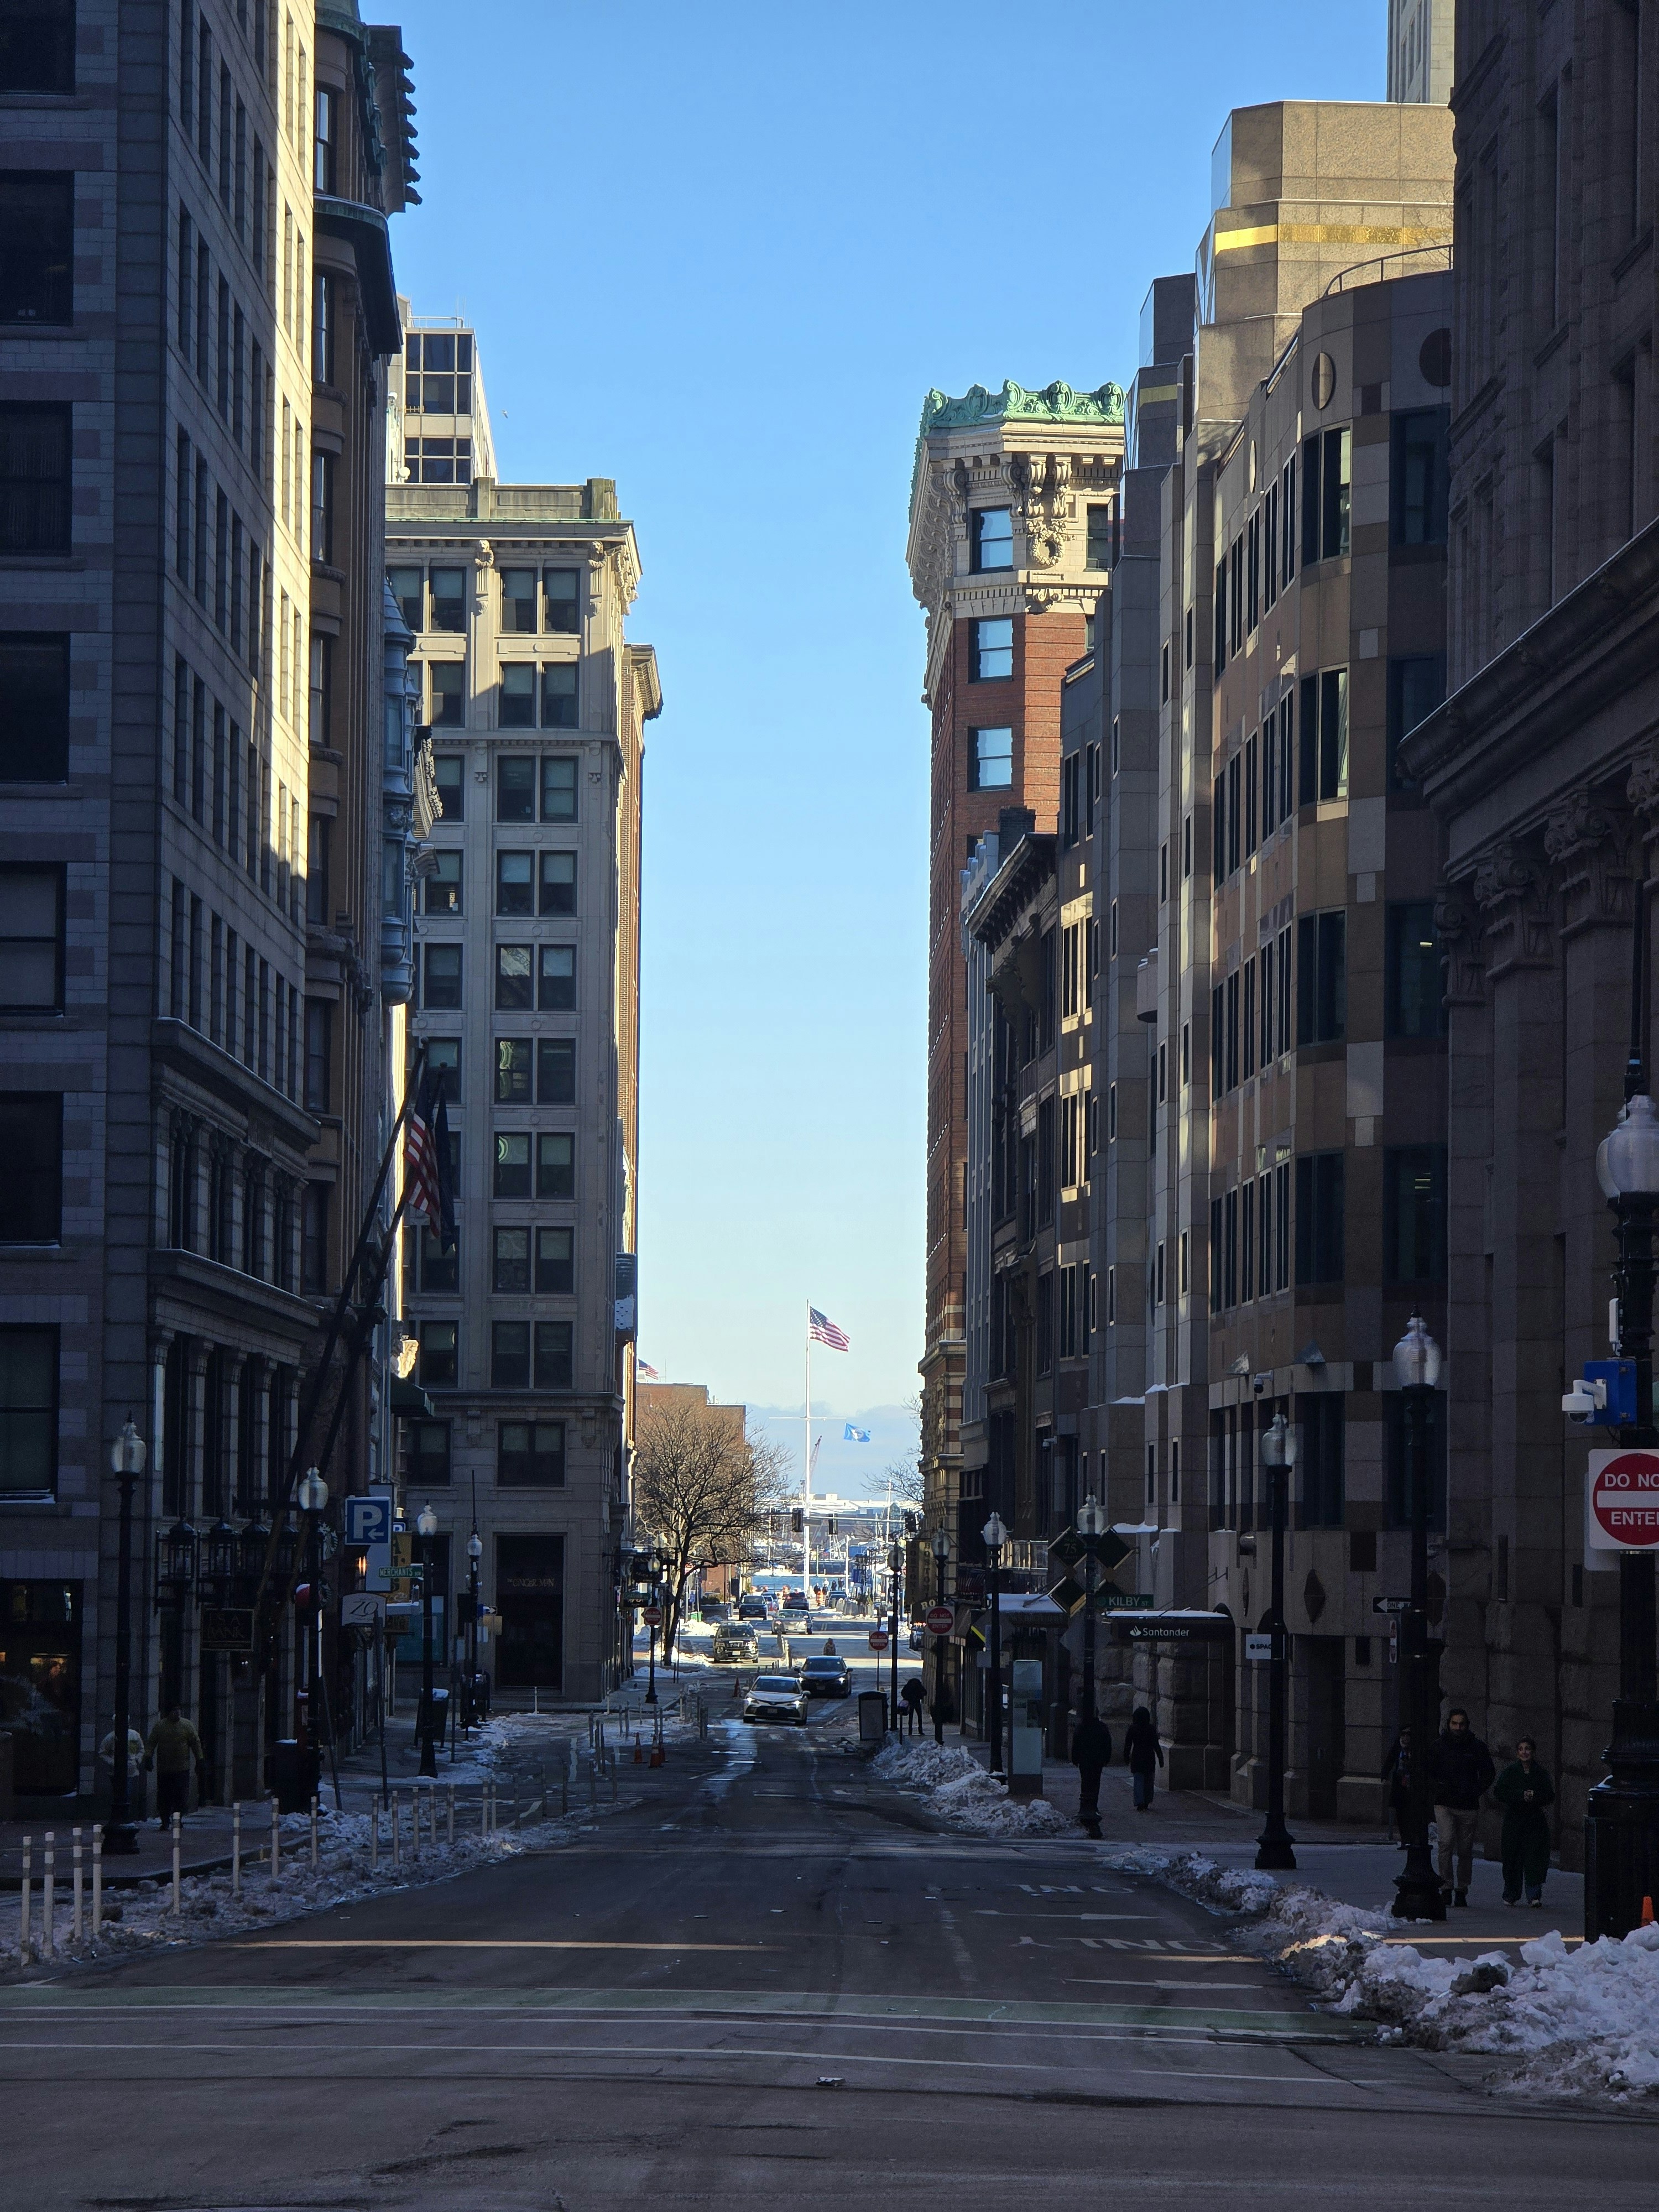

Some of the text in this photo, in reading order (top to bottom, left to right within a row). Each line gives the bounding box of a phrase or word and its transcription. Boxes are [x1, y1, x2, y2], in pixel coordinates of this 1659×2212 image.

[1604, 1473, 1659, 1488] DO NO
[353, 1504, 383, 1540] P
[1610, 1511, 1659, 1526] ENTE
[1063, 1543, 1077, 1554] 75
[379, 1567, 414, 1577] MERCHANTS
[923, 1542, 931, 1597] BOSTONI
[1108, 1597, 1140, 1606] KILBY
[1142, 1628, 1190, 1637] Santander
